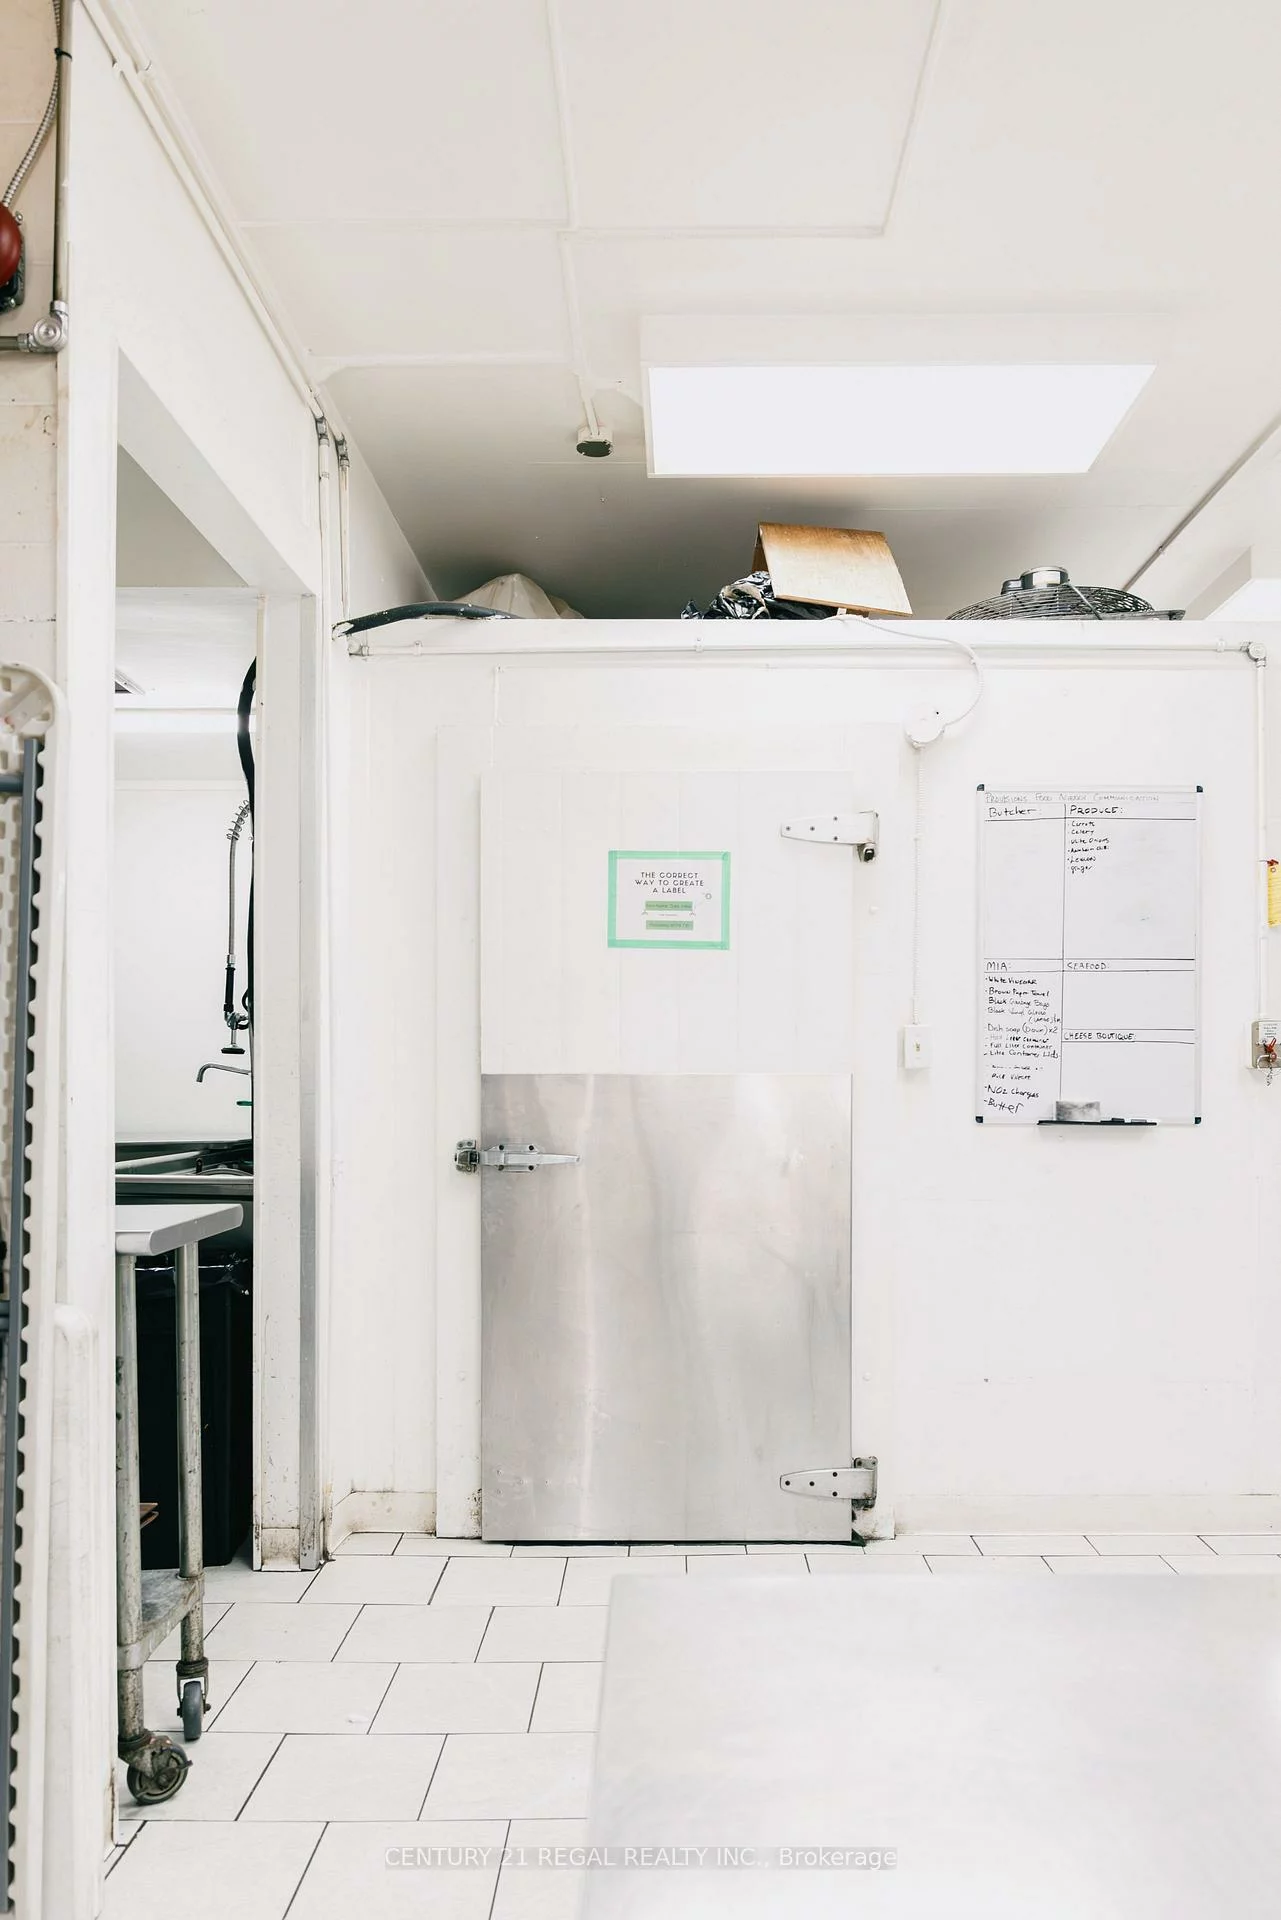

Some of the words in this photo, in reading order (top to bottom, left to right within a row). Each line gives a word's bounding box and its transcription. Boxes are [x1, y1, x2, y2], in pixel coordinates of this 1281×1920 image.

[1070, 804, 1123, 815] PRODUCE:
[641, 871, 656, 879] THE
[1063, 1032, 1093, 1041] CHEESE
